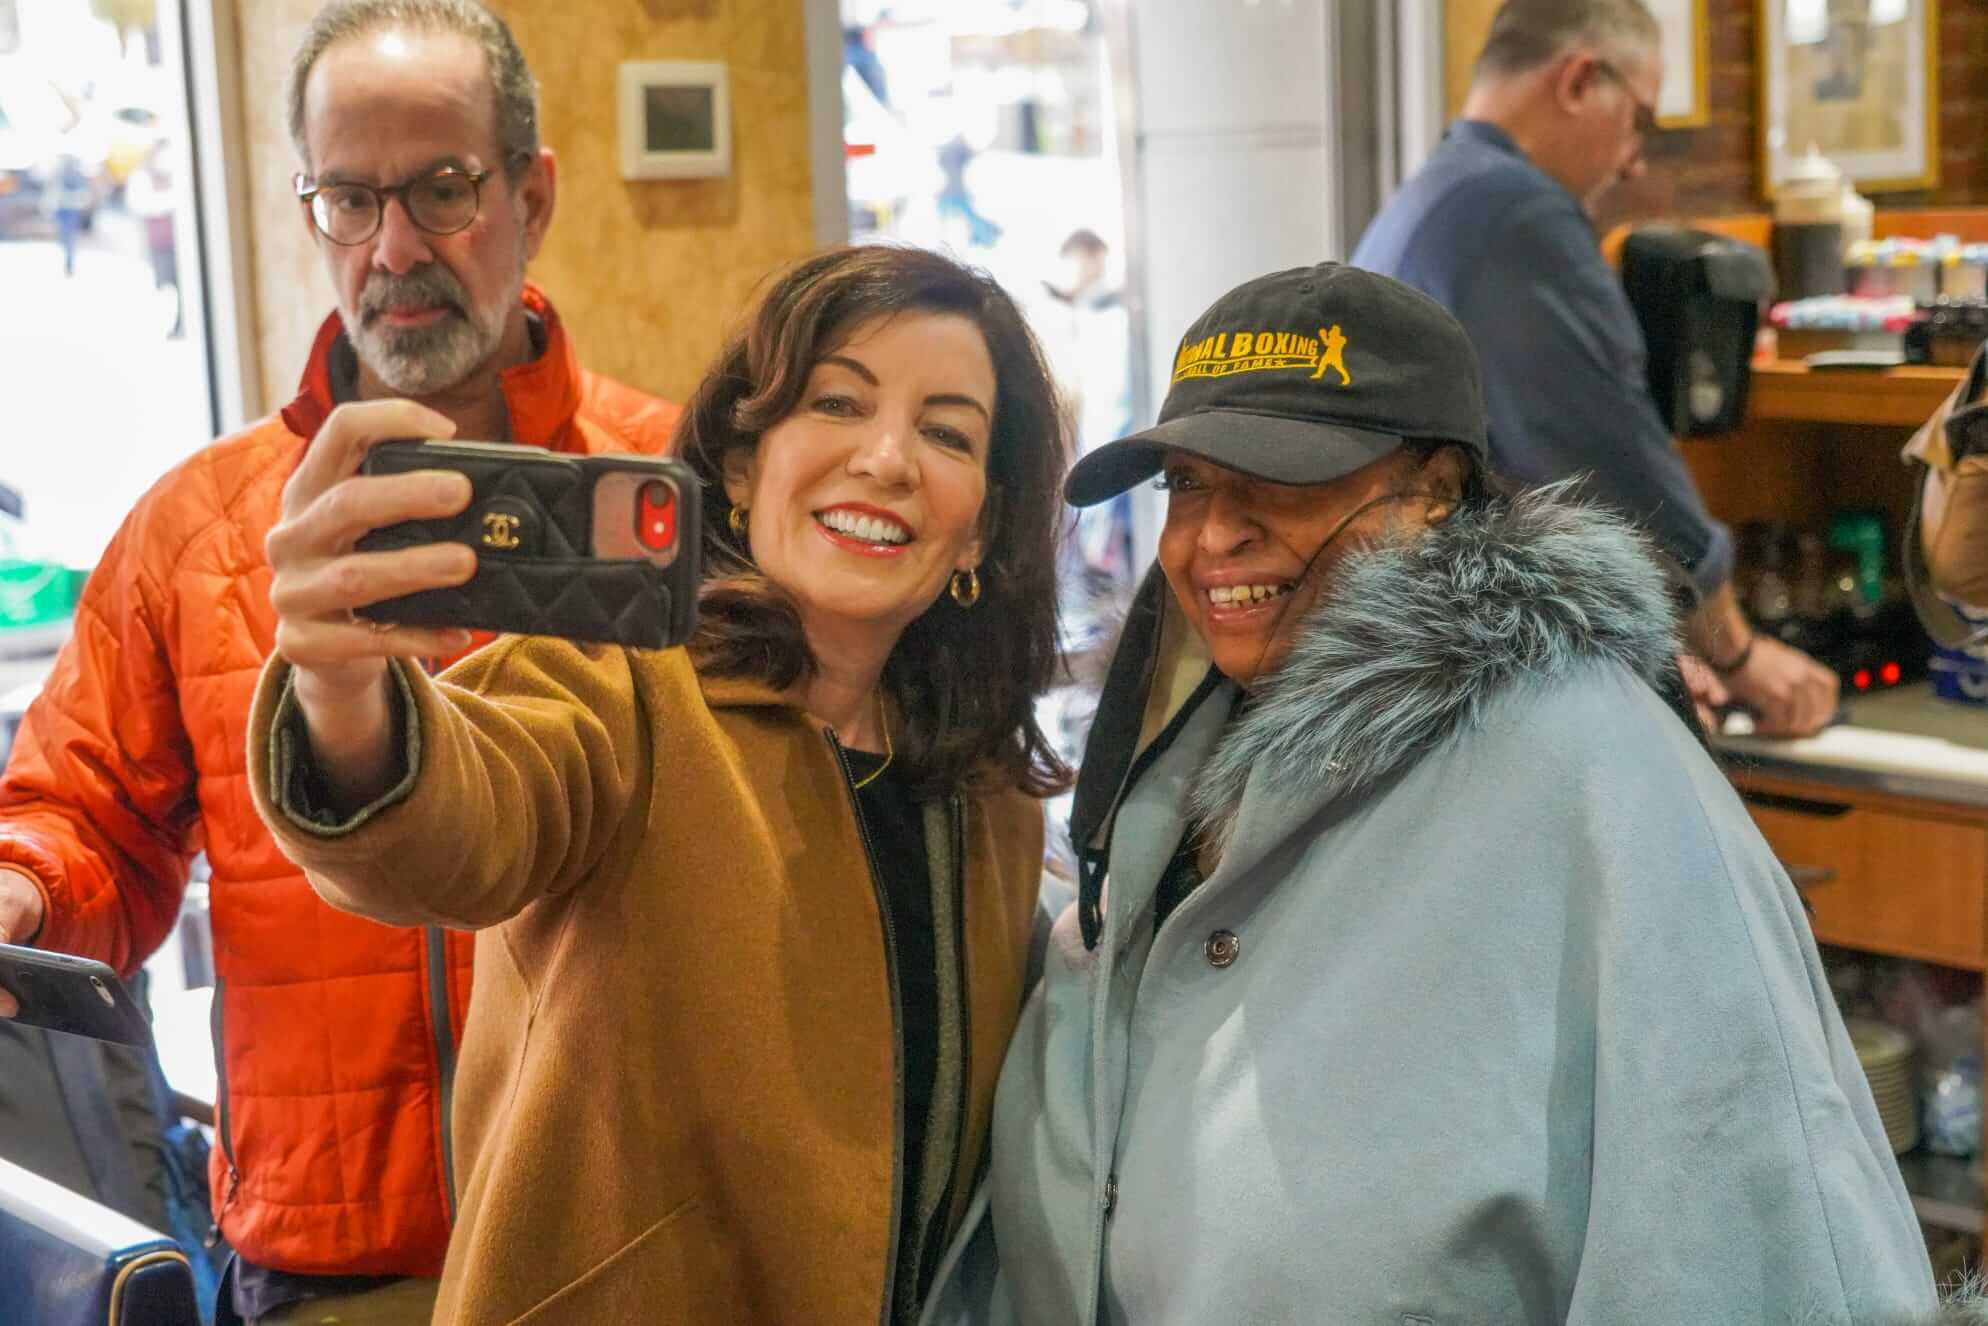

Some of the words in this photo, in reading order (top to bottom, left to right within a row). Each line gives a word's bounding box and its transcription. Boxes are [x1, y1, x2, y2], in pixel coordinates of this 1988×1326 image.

[1230, 332, 1318, 358] BOXING
[1212, 364, 1228, 375] OF
[1233, 358, 1273, 371] FAME
